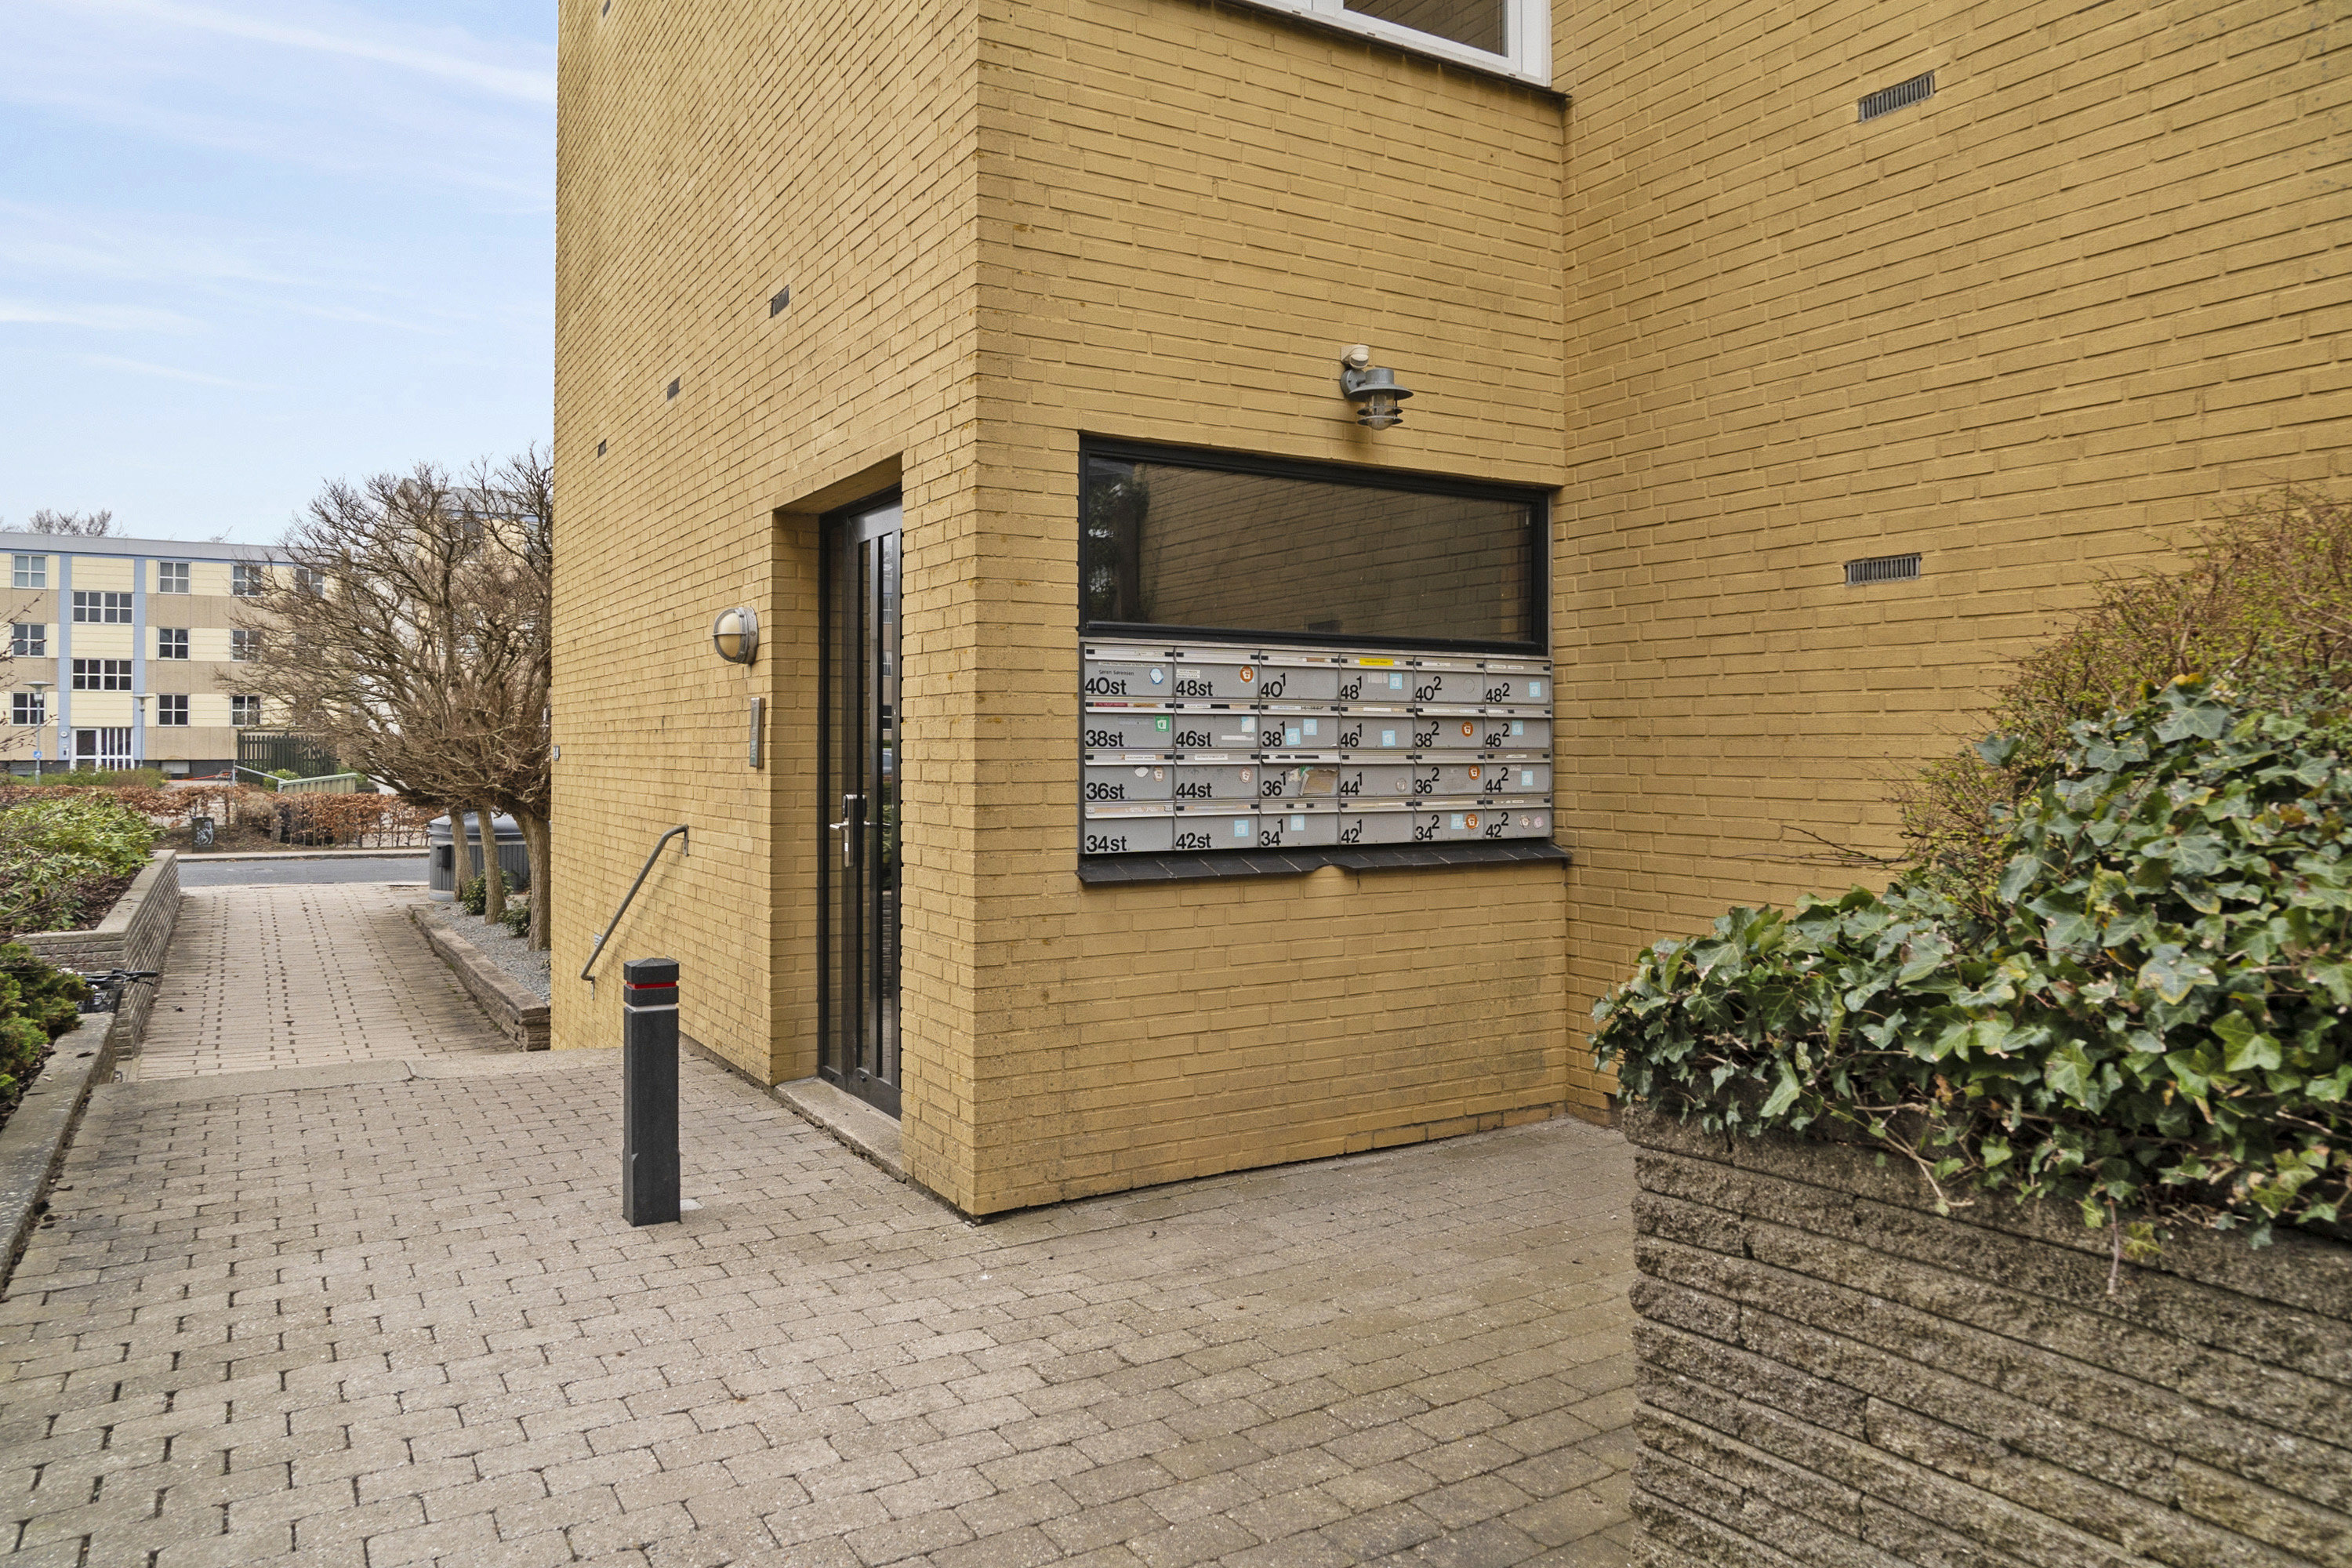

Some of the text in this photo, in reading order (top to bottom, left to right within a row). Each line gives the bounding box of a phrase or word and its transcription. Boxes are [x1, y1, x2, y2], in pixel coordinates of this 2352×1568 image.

[1085, 677, 1126, 695] 40st
[1176, 680, 1213, 696] 48st
[1085, 730, 1123, 746] 38st
[1176, 731, 1211, 747] 46st
[1087, 782, 1124, 800] 36st
[1175, 783, 1212, 798] 44st
[1087, 835, 1127, 853] 34st
[1176, 833, 1211, 849] 42st
